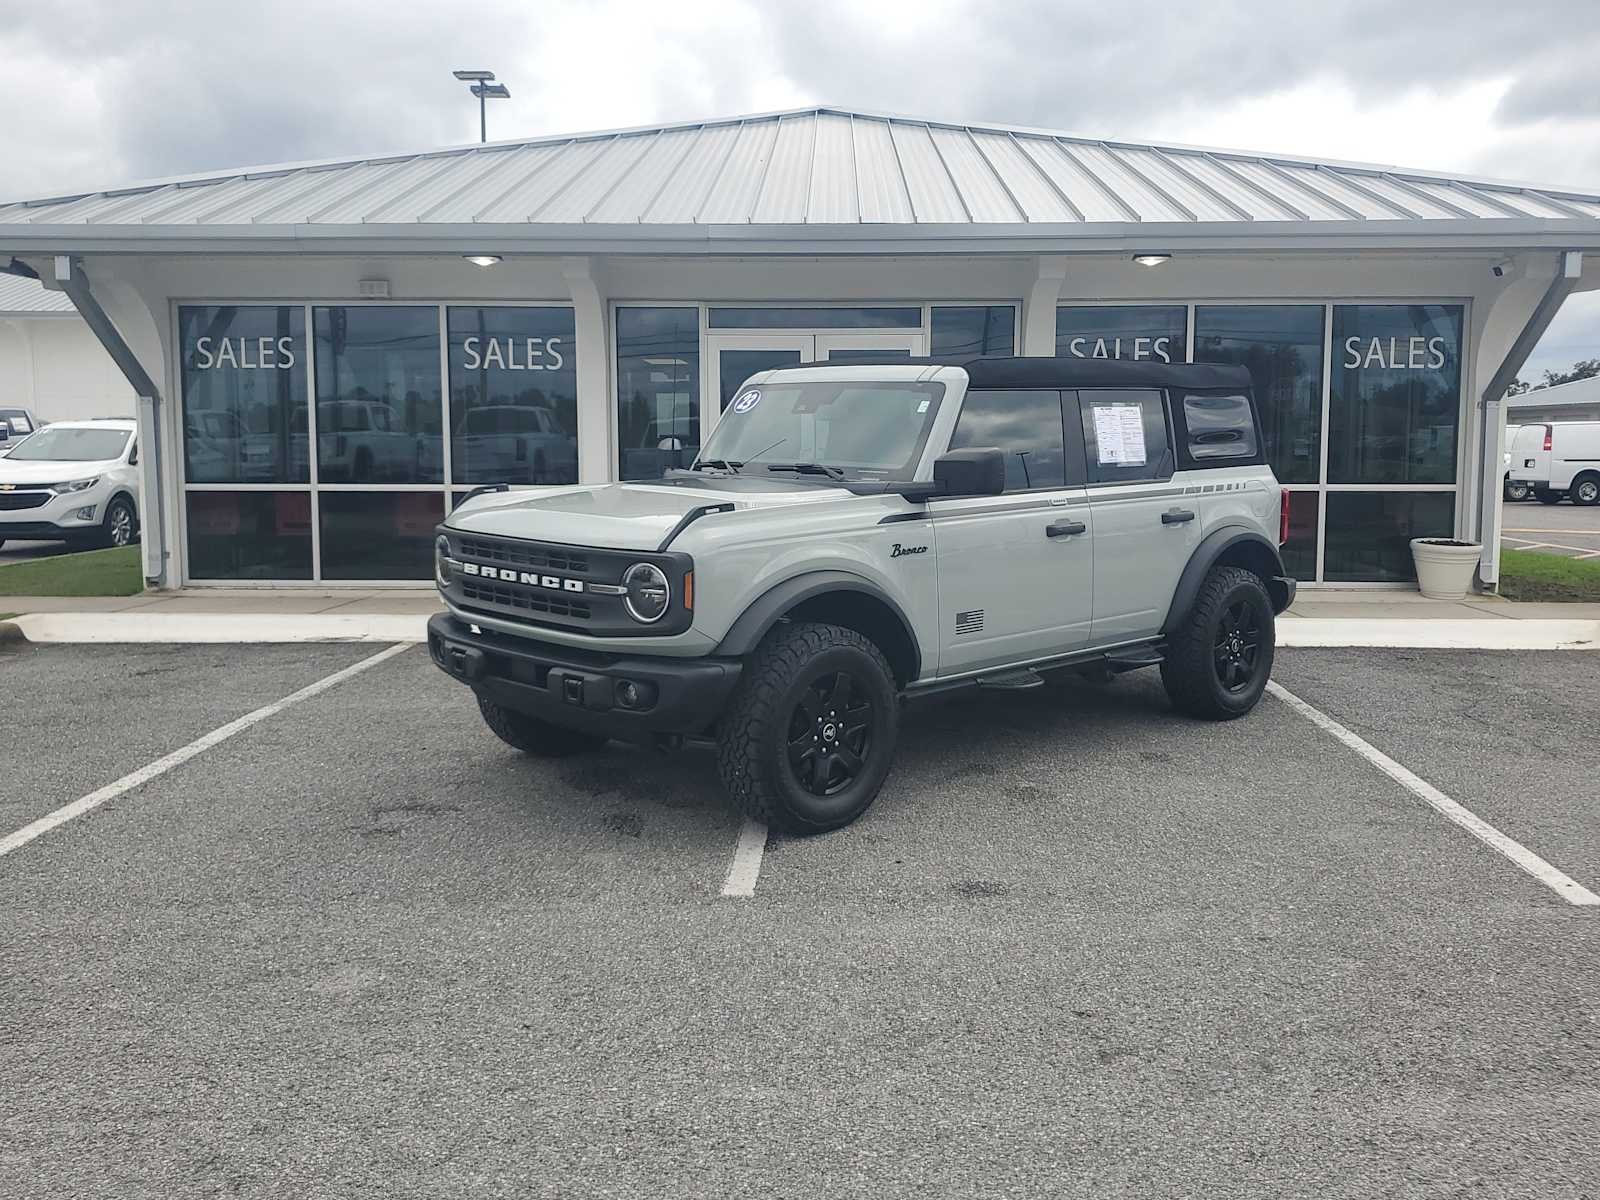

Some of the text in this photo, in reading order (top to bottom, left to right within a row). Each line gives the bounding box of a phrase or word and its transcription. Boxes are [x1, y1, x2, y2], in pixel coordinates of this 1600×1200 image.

[196, 336, 295, 370] SALES
[463, 336, 564, 371] SALES
[1343, 335, 1445, 370] SALES
[736, 392, 758, 410] 23
[890, 543, 929, 558] Bronco
[463, 563, 584, 593] BRONCO
